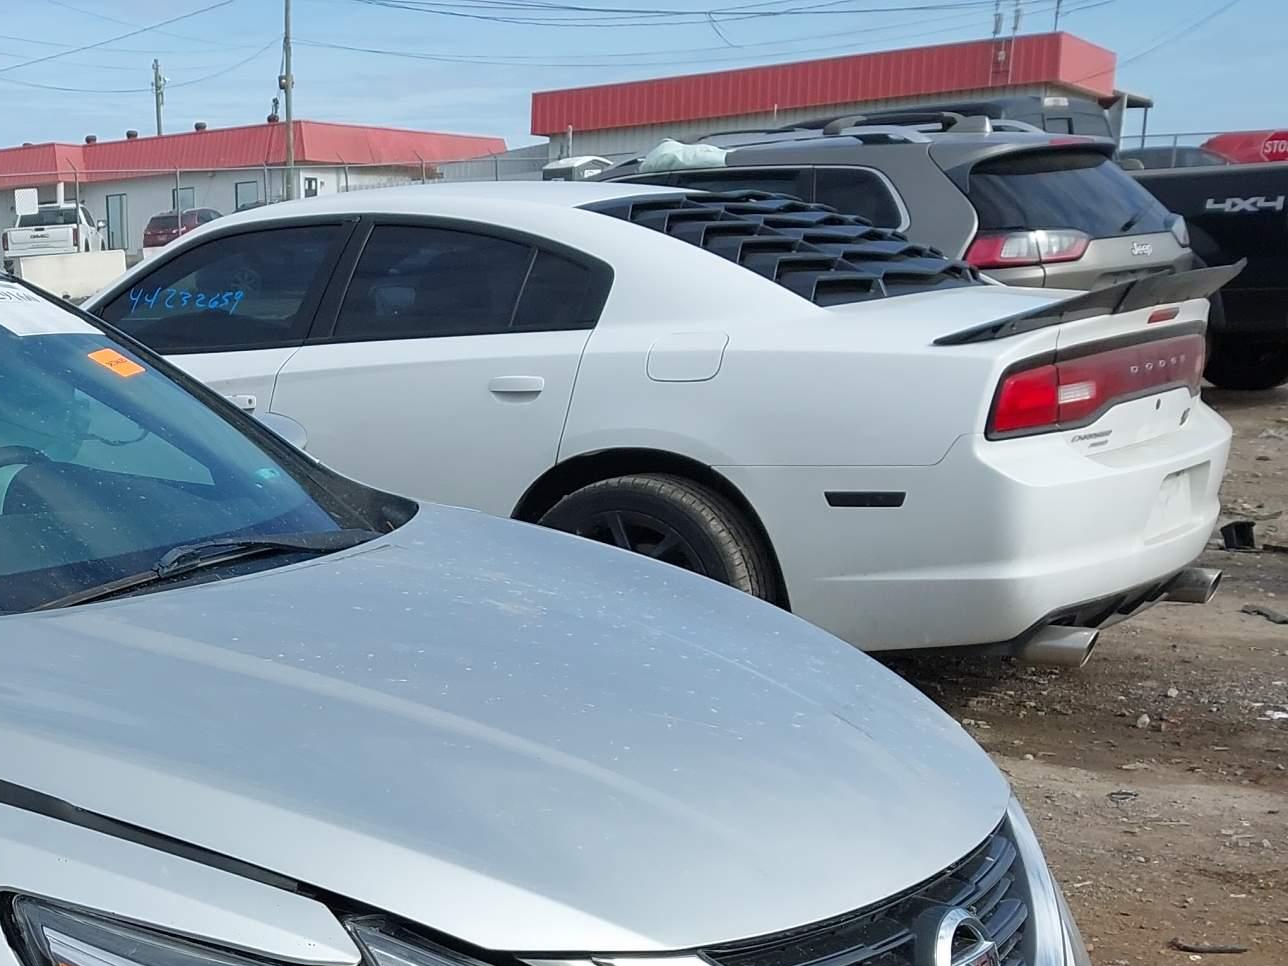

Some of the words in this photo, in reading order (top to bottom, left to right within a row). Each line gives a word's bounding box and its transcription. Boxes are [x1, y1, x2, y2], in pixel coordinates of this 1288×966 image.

[1264, 140, 1288, 153] STO
[1131, 241, 1153, 256] Jeep
[129, 286, 244, 316] 44232659
